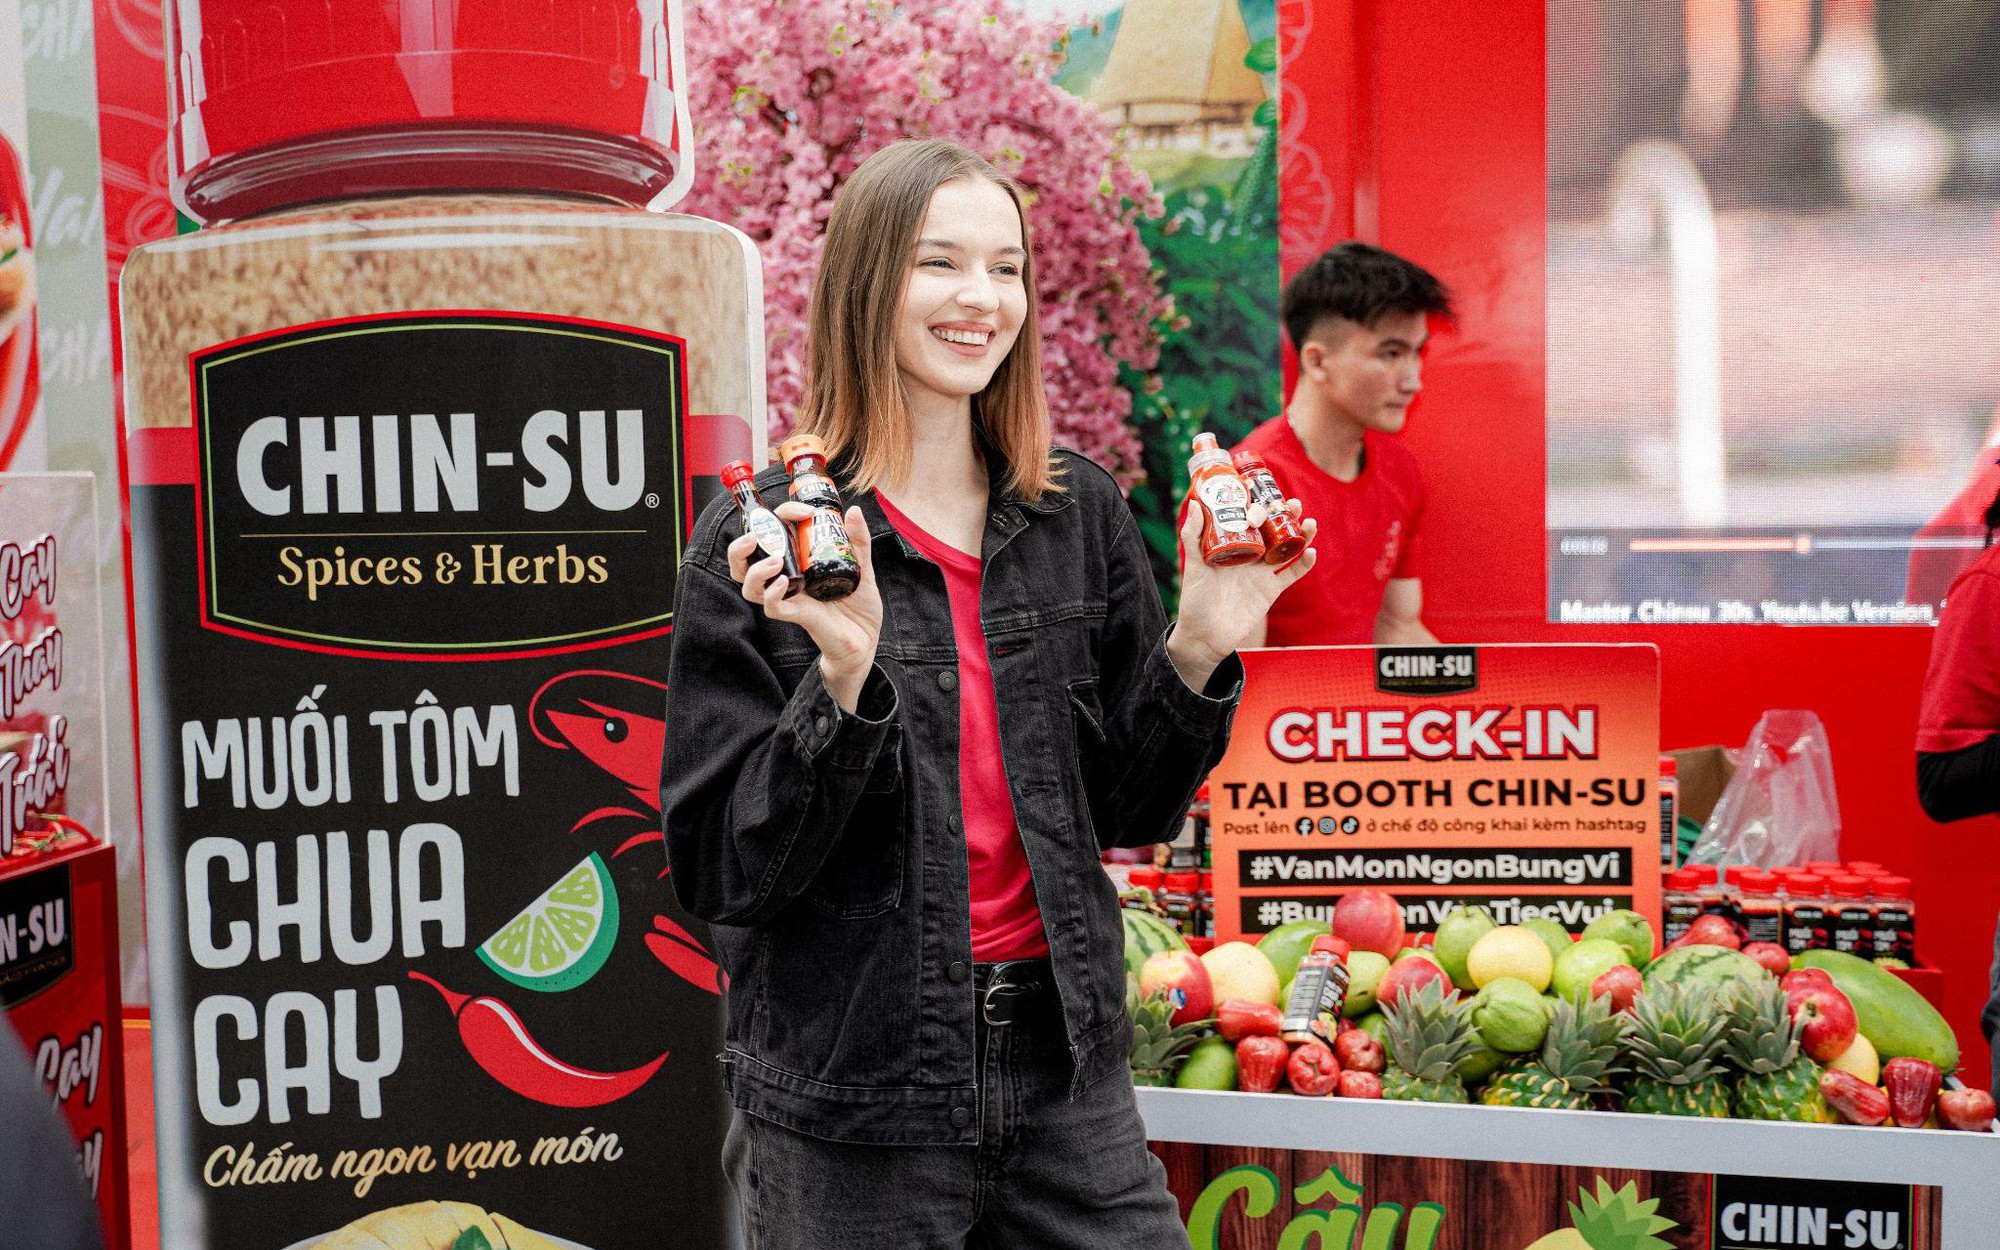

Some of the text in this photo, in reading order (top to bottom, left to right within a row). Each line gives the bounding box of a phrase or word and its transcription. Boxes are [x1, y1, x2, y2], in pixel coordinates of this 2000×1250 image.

[236, 409, 646, 516] CHIN-SU
[0, 536, 57, 620] Cay
[277, 544, 609, 602] Spices & Herbs
[0, 629, 62, 720] Thay
[1380, 655, 1473, 678] CHIN-SU
[181, 684, 520, 810] MUỐI TÔM
[1267, 707, 1598, 760] CHECK-IN
[1223, 778, 1646, 817] TẠI BOOTH CHIN-SU
[1223, 822, 1260, 835] Post
[1264, 821, 1290, 834] lên
[1381, 817, 1412, 832] chế
[1416, 817, 1439, 834] độ
[1443, 817, 1486, 834] công
[1491, 817, 1528, 831] khai
[1576, 817, 1646, 833] hashtag
[185, 822, 466, 969] CHUA
[1250, 852, 1620, 882] #VanMonNgonBungVi
[194, 985, 403, 1126] CAY
[204, 1127, 623, 1199] Chấm ngon vạn món
[1721, 1202, 1900, 1250] CHIN-SU
